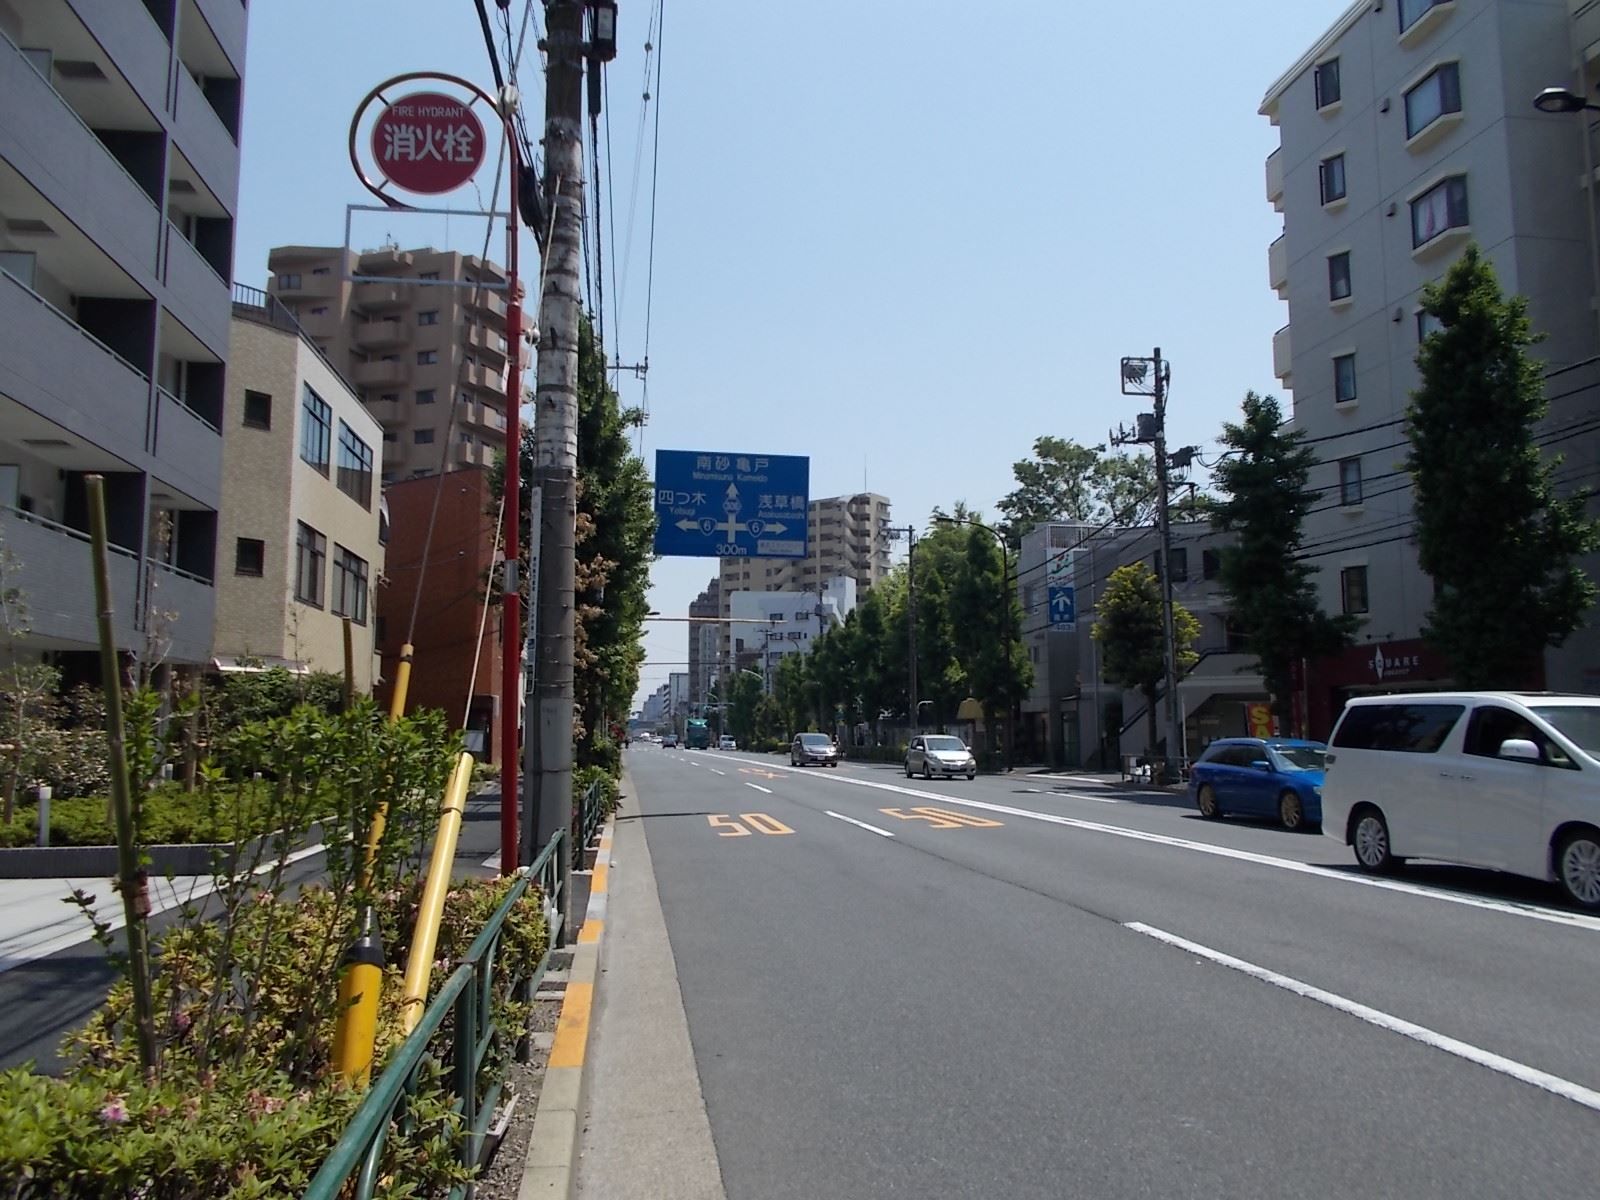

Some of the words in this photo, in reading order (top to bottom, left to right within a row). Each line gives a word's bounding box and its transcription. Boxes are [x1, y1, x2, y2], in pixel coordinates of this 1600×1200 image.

[392, 106, 414, 117] FIRE
[418, 106, 464, 117] HYDRANT
[384, 123, 476, 163] 消火栓
[696, 455, 730, 471] 南砂
[658, 490, 706, 506] 四つ木
[752, 522, 760, 533] 6
[715, 543, 748, 555] 300m
[706, 812, 796, 837] 50
